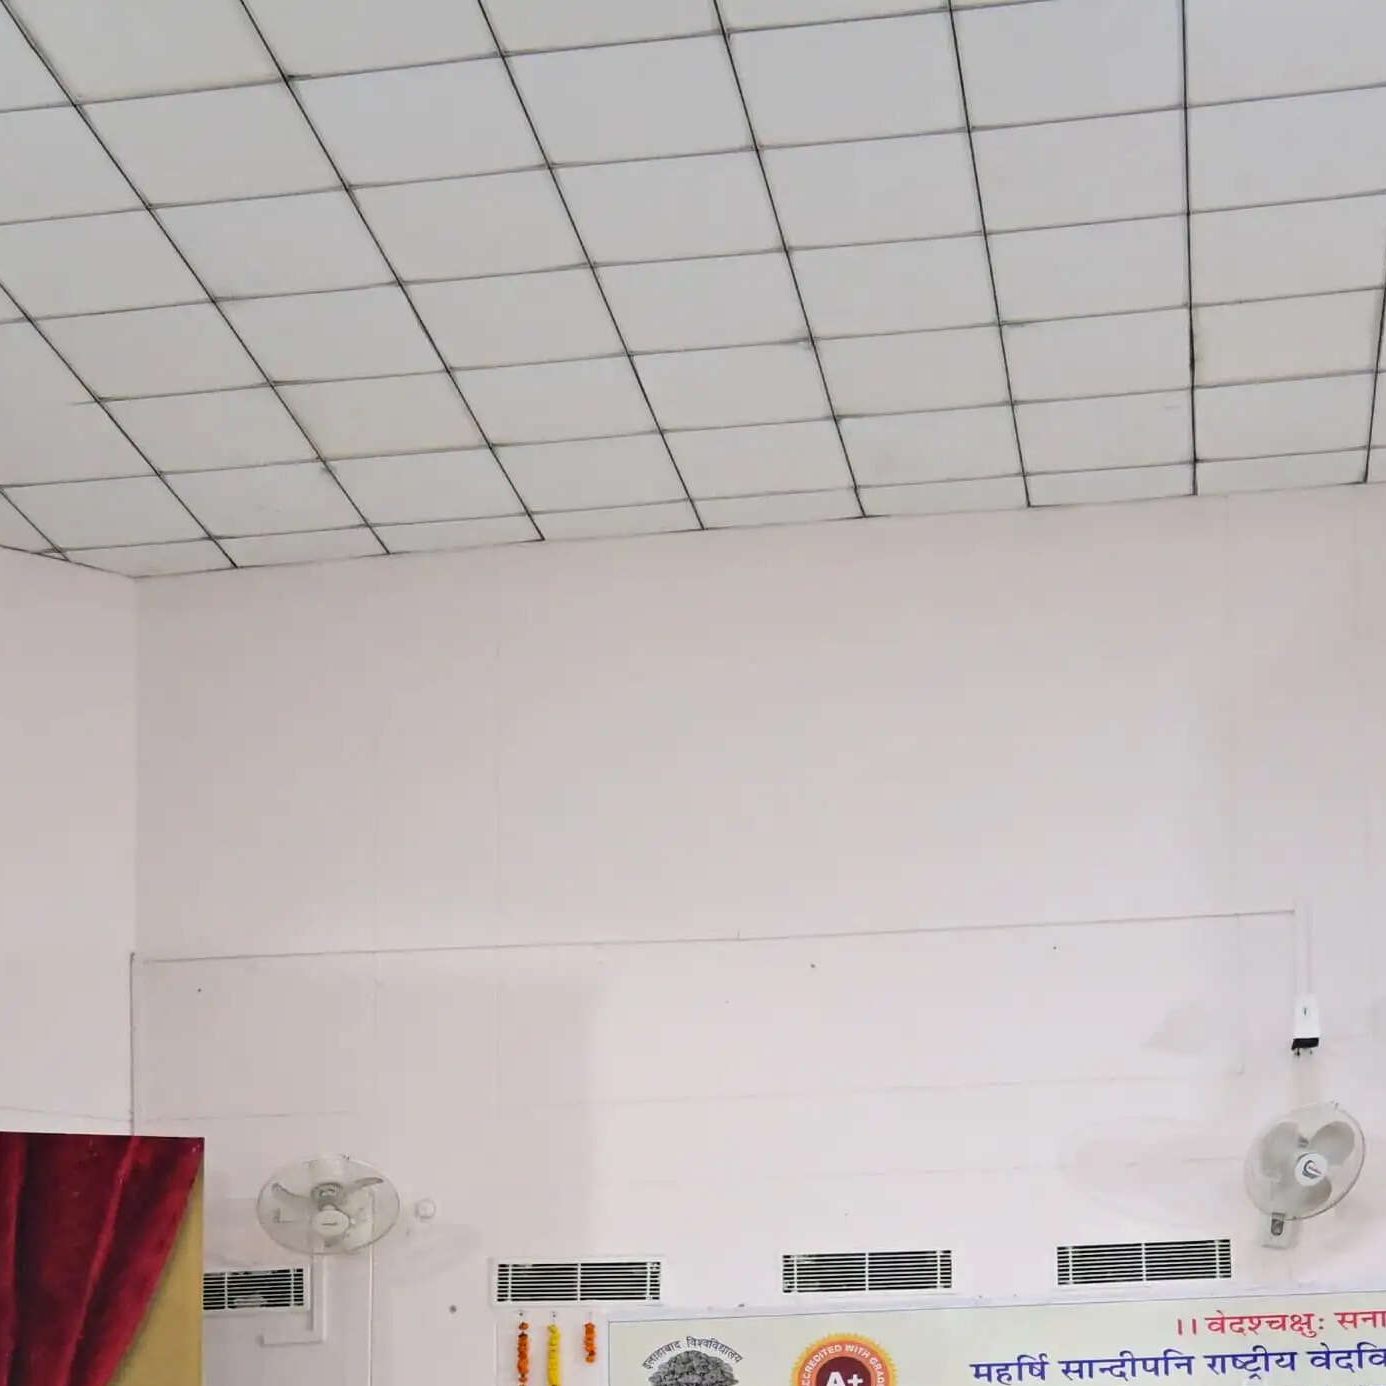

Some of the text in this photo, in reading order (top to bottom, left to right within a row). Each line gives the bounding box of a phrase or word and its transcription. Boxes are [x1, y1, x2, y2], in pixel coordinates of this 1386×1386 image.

[845, 1344, 870, 1359] WITH
[969, 1353, 1049, 1386] महर्षि
[1058, 1348, 1195, 1381] सान्दीपनि
[1203, 1345, 1298, 1380] राष्ट्रीय
